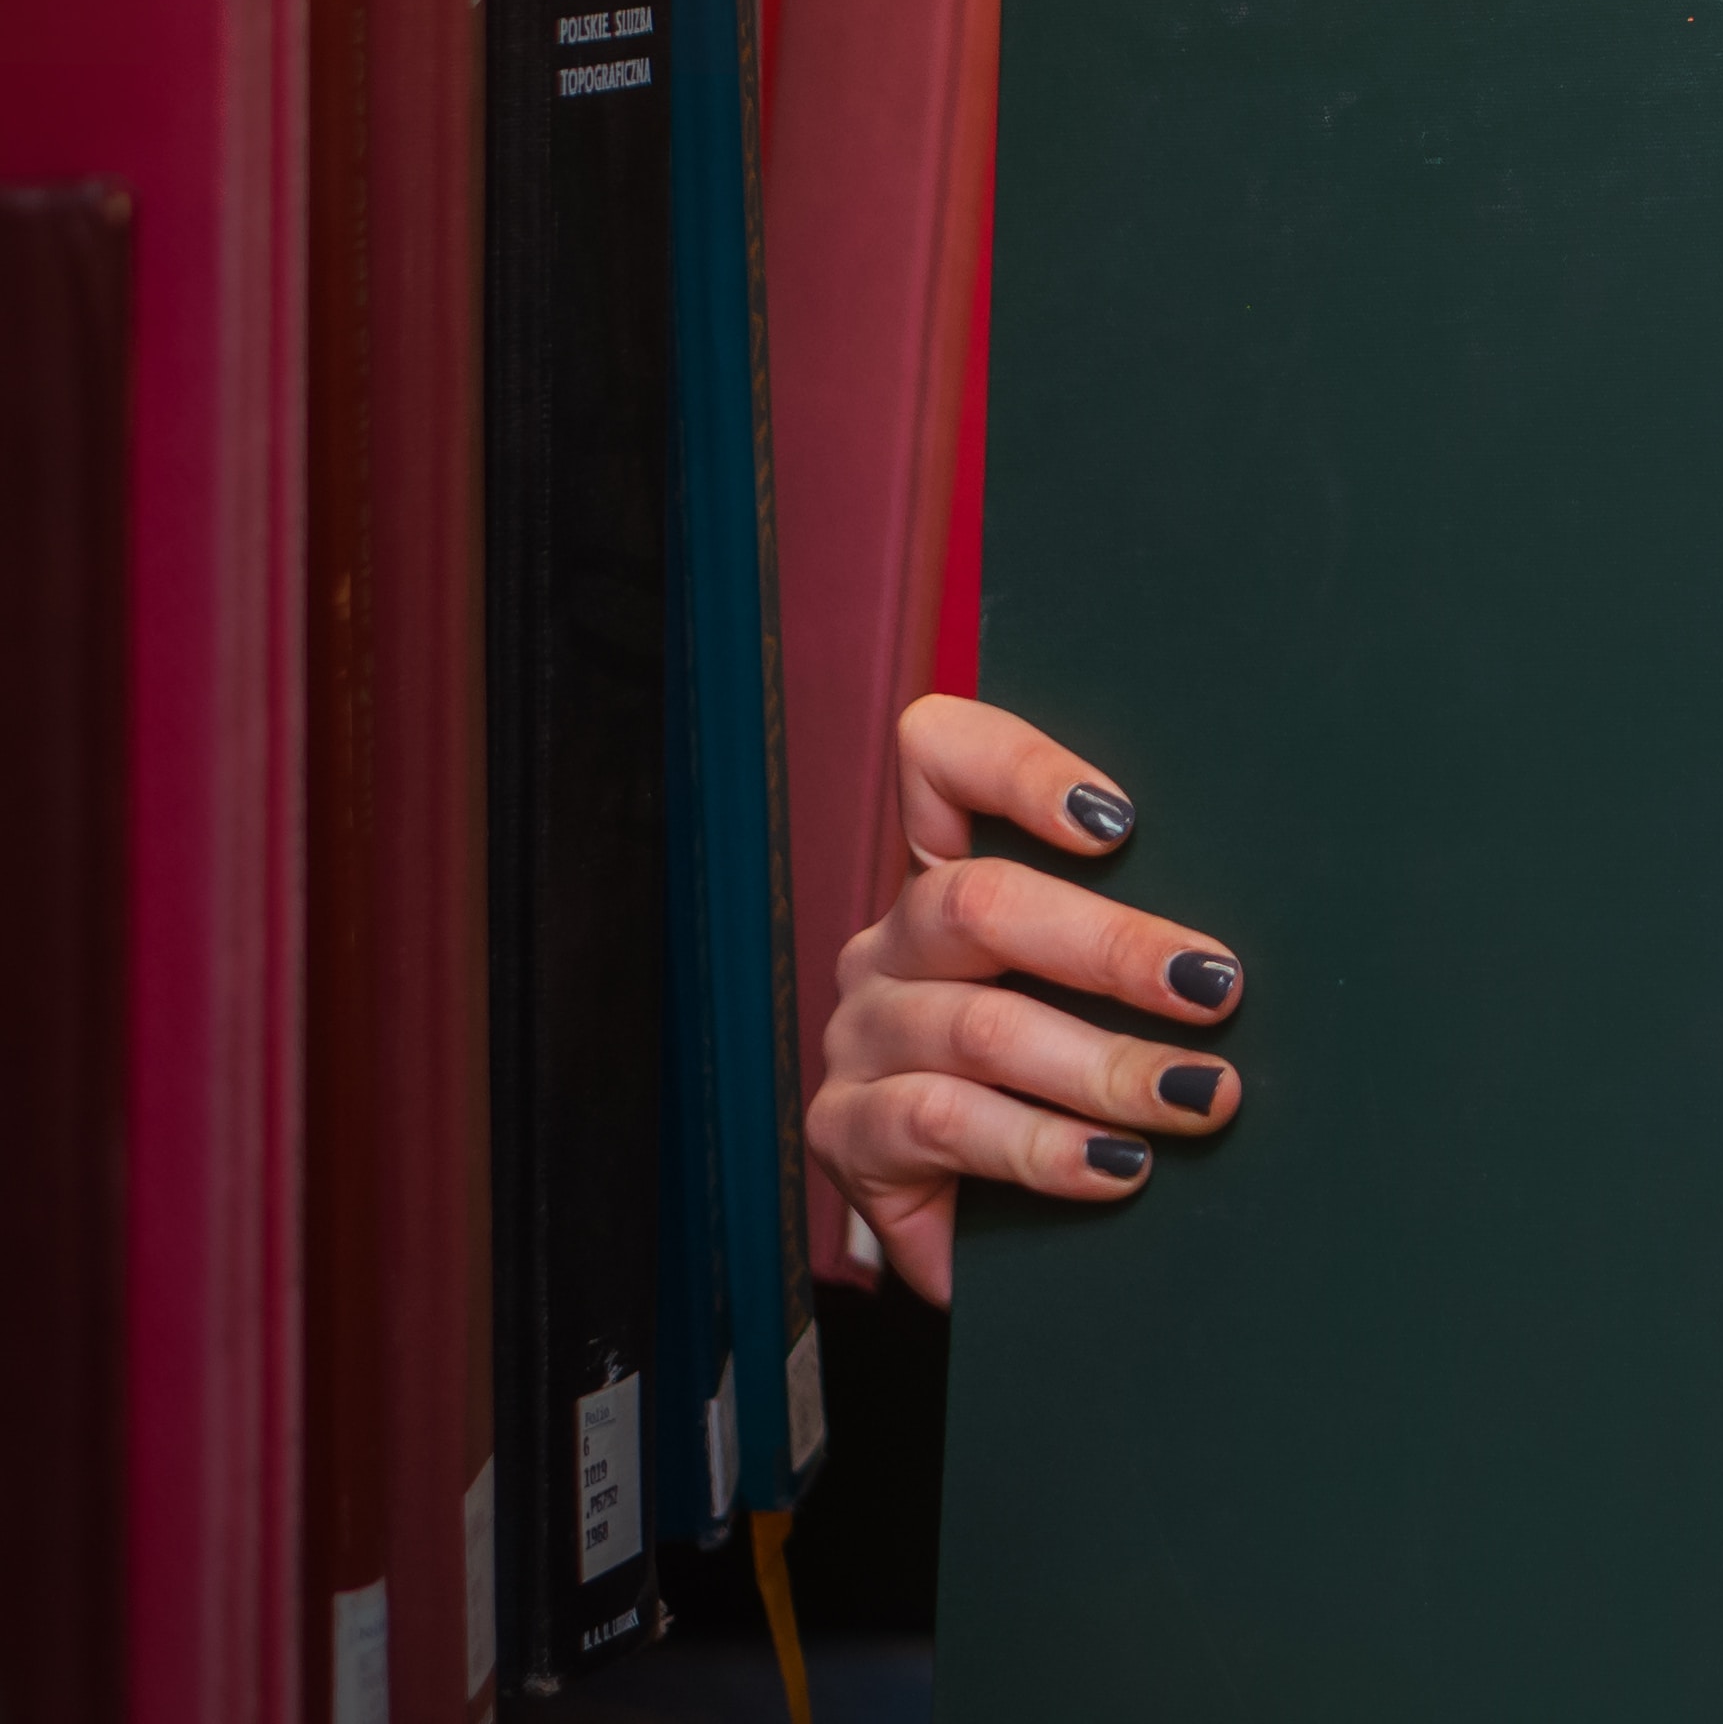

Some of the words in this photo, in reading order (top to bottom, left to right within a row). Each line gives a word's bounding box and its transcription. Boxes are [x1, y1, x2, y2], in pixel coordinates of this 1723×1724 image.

[614, 6, 654, 36] SLUZBA
[558, 57, 652, 97] TOPOGRAFICZNA
[585, 1406, 610, 1428] Folio
[583, 1458, 608, 1488] 1019
